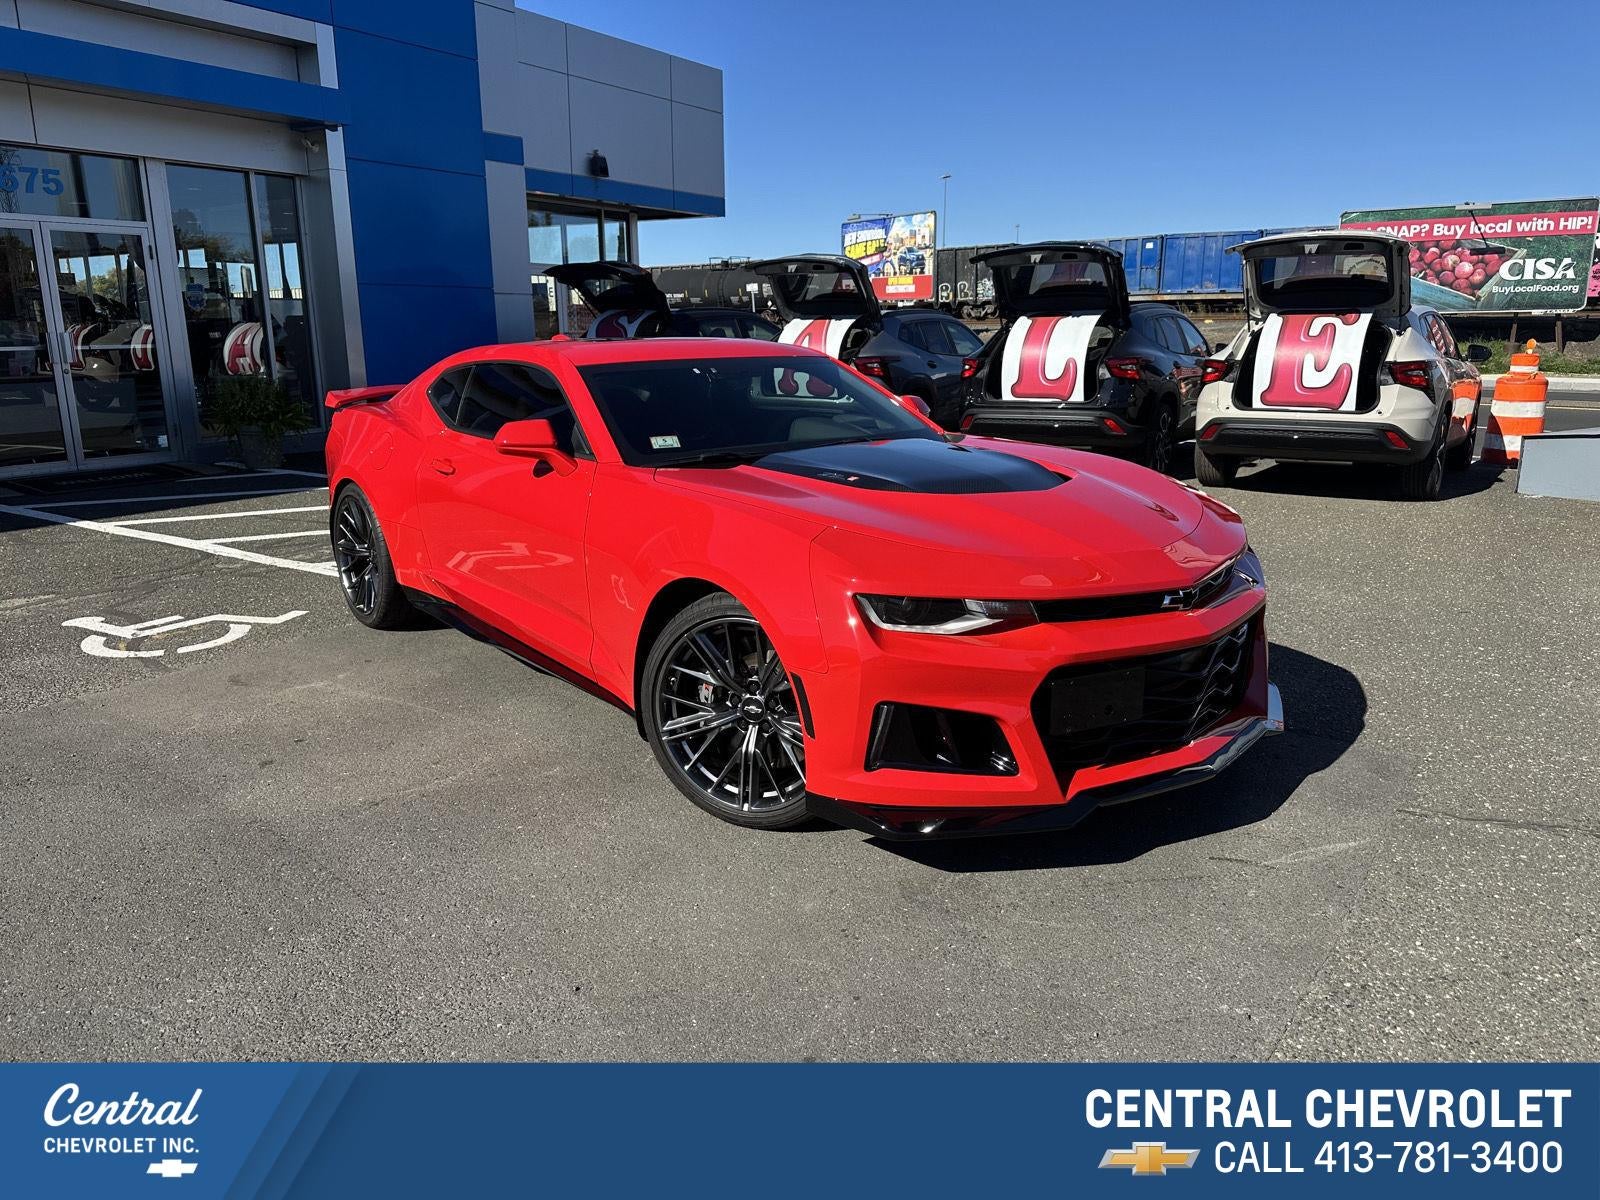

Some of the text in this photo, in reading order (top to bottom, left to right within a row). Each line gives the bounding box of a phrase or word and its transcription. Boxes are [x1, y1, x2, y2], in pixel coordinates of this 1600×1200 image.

[0, 165, 64, 195] 675
[1433, 223, 1466, 239] Buy
[1470, 219, 1511, 235] local
[1517, 217, 1554, 232] with
[1559, 216, 1592, 231] HIP!
[1499, 258, 1576, 280] CISA
[1492, 284, 1579, 295] BuyLocalFood.org
